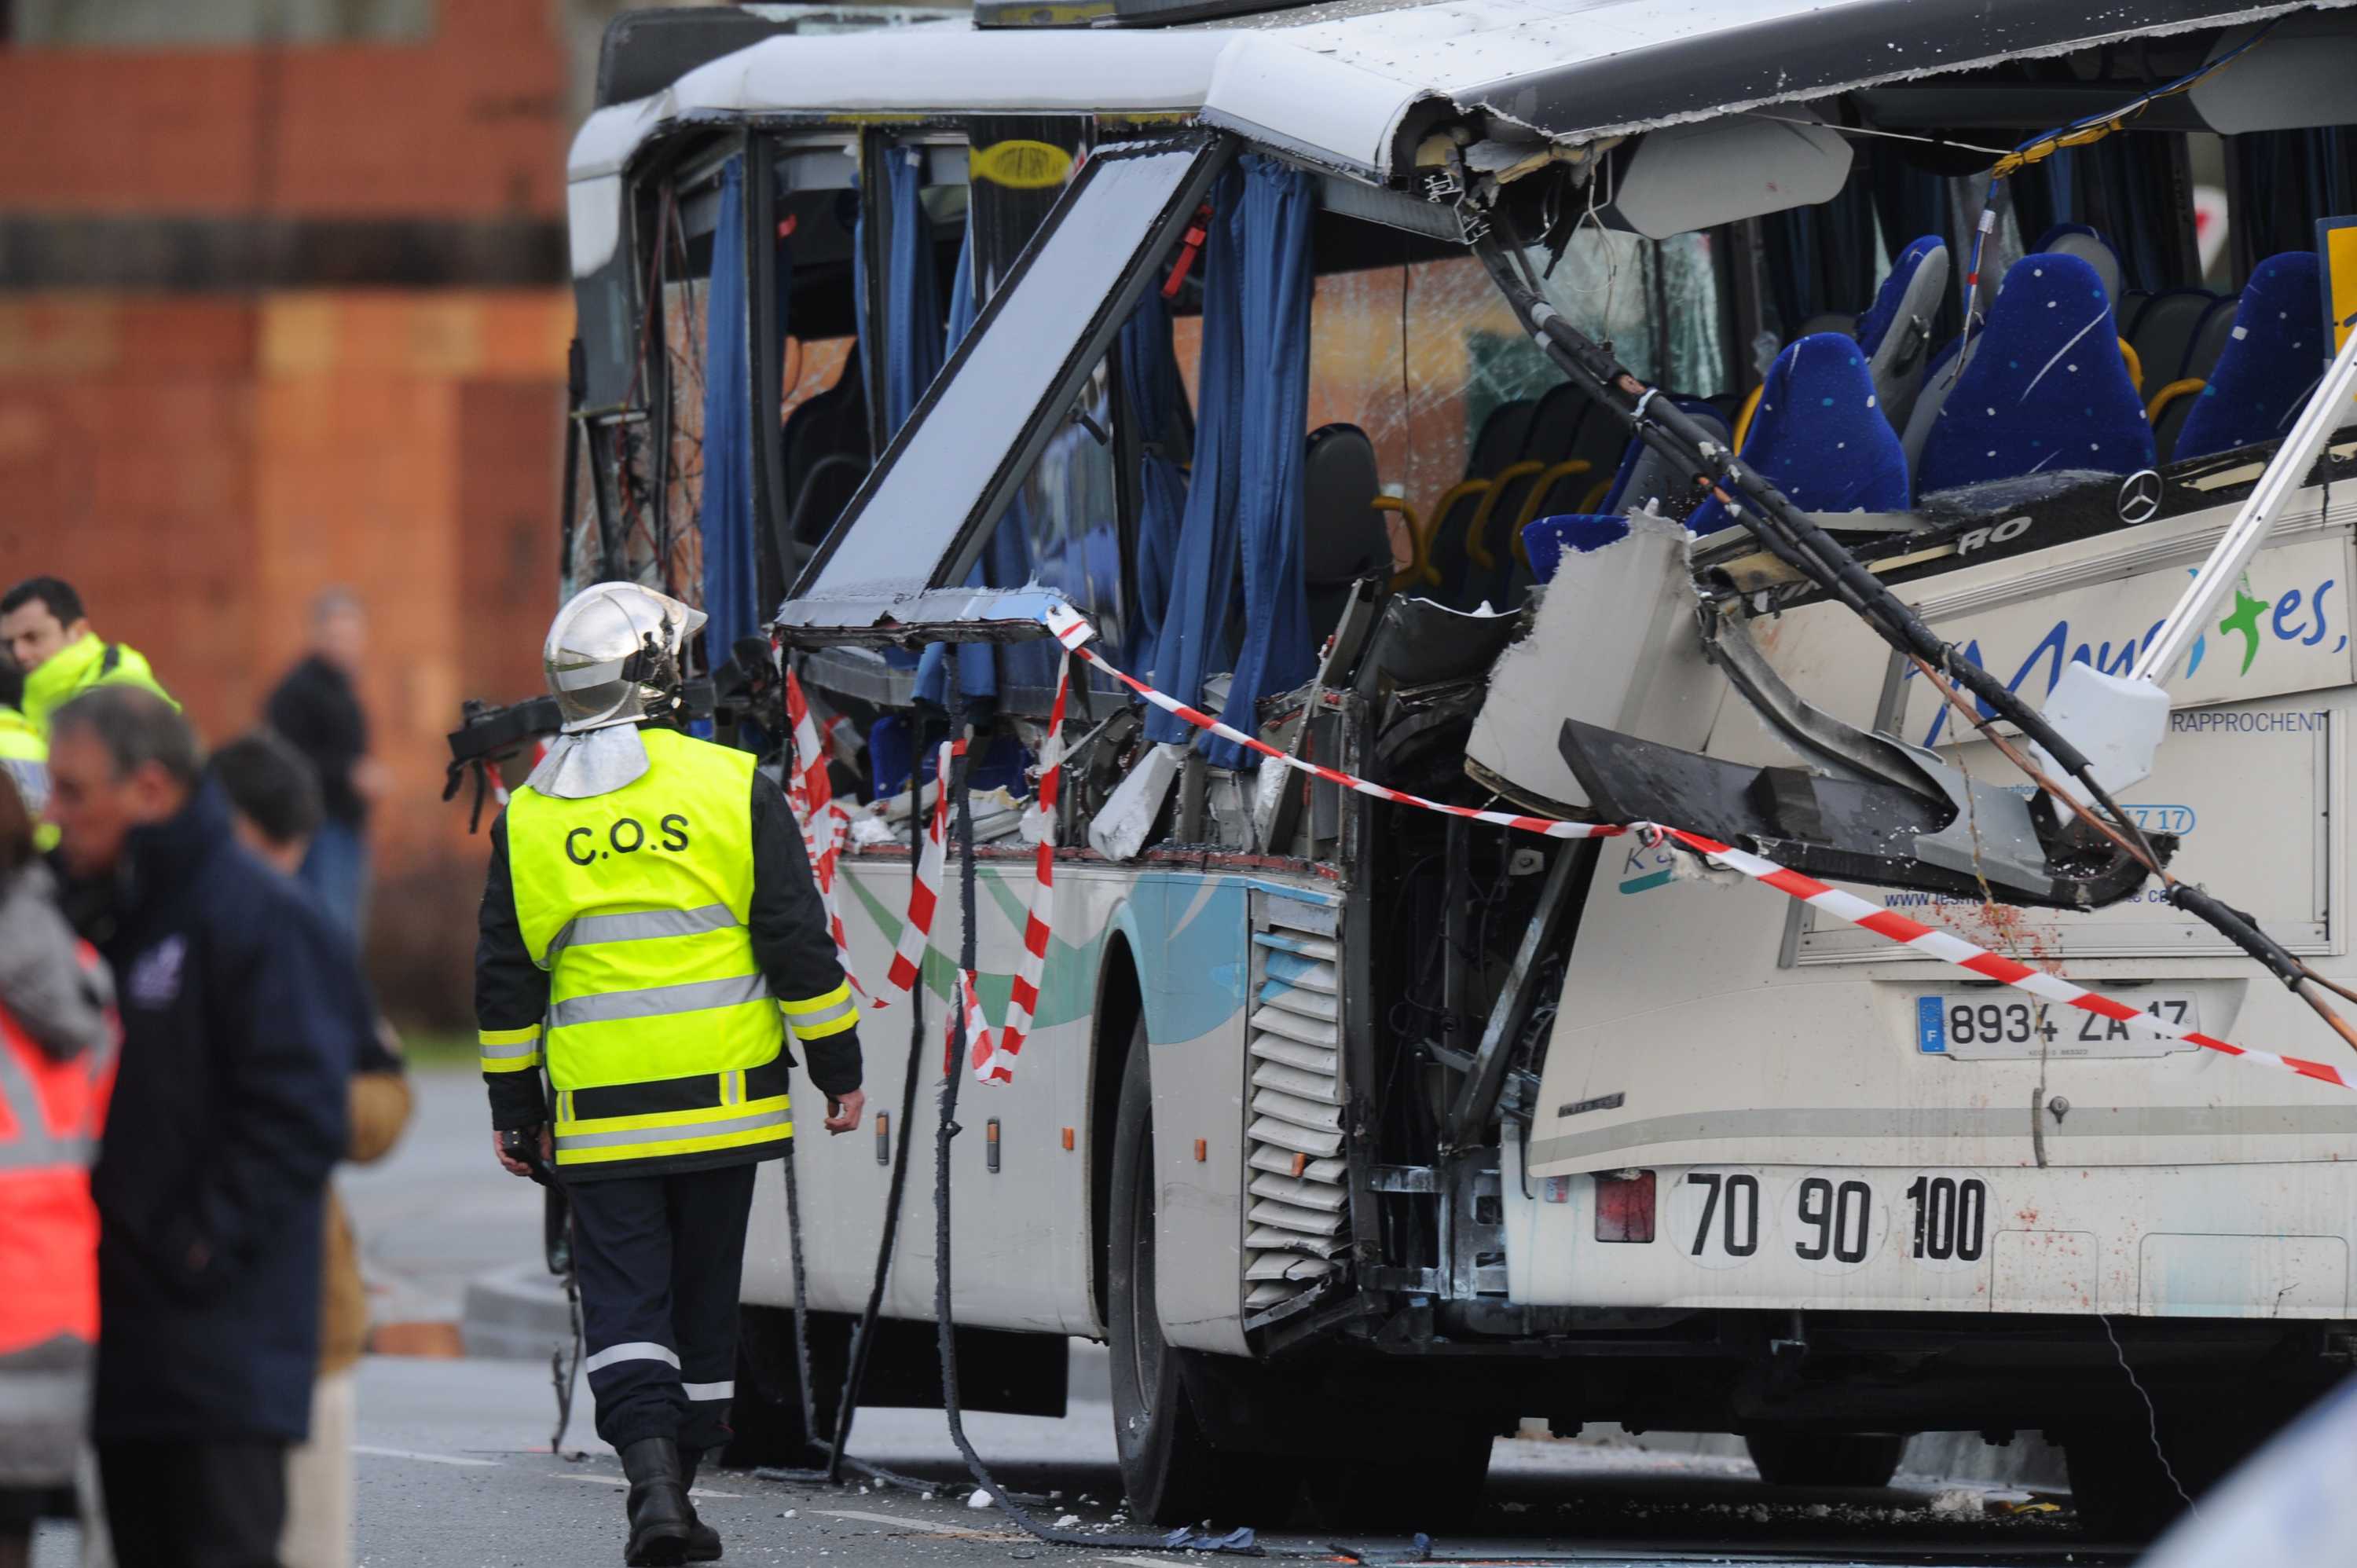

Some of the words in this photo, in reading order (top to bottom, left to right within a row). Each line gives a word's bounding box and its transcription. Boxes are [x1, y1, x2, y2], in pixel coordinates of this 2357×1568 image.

[2172, 712, 2327, 732] RAPPROCHENT
[2157, 810, 2186, 830] 17
[566, 813, 689, 866] C.O.S
[1926, 1030, 1937, 1042] F
[1950, 1002, 2058, 1044] 8934
[2079, 1007, 2130, 1042] ZA
[2147, 1001, 2188, 1039] 17
[1687, 1173, 1759, 1257] 70
[1795, 1177, 1871, 1263] 90
[1907, 1176, 1986, 1262] 100
